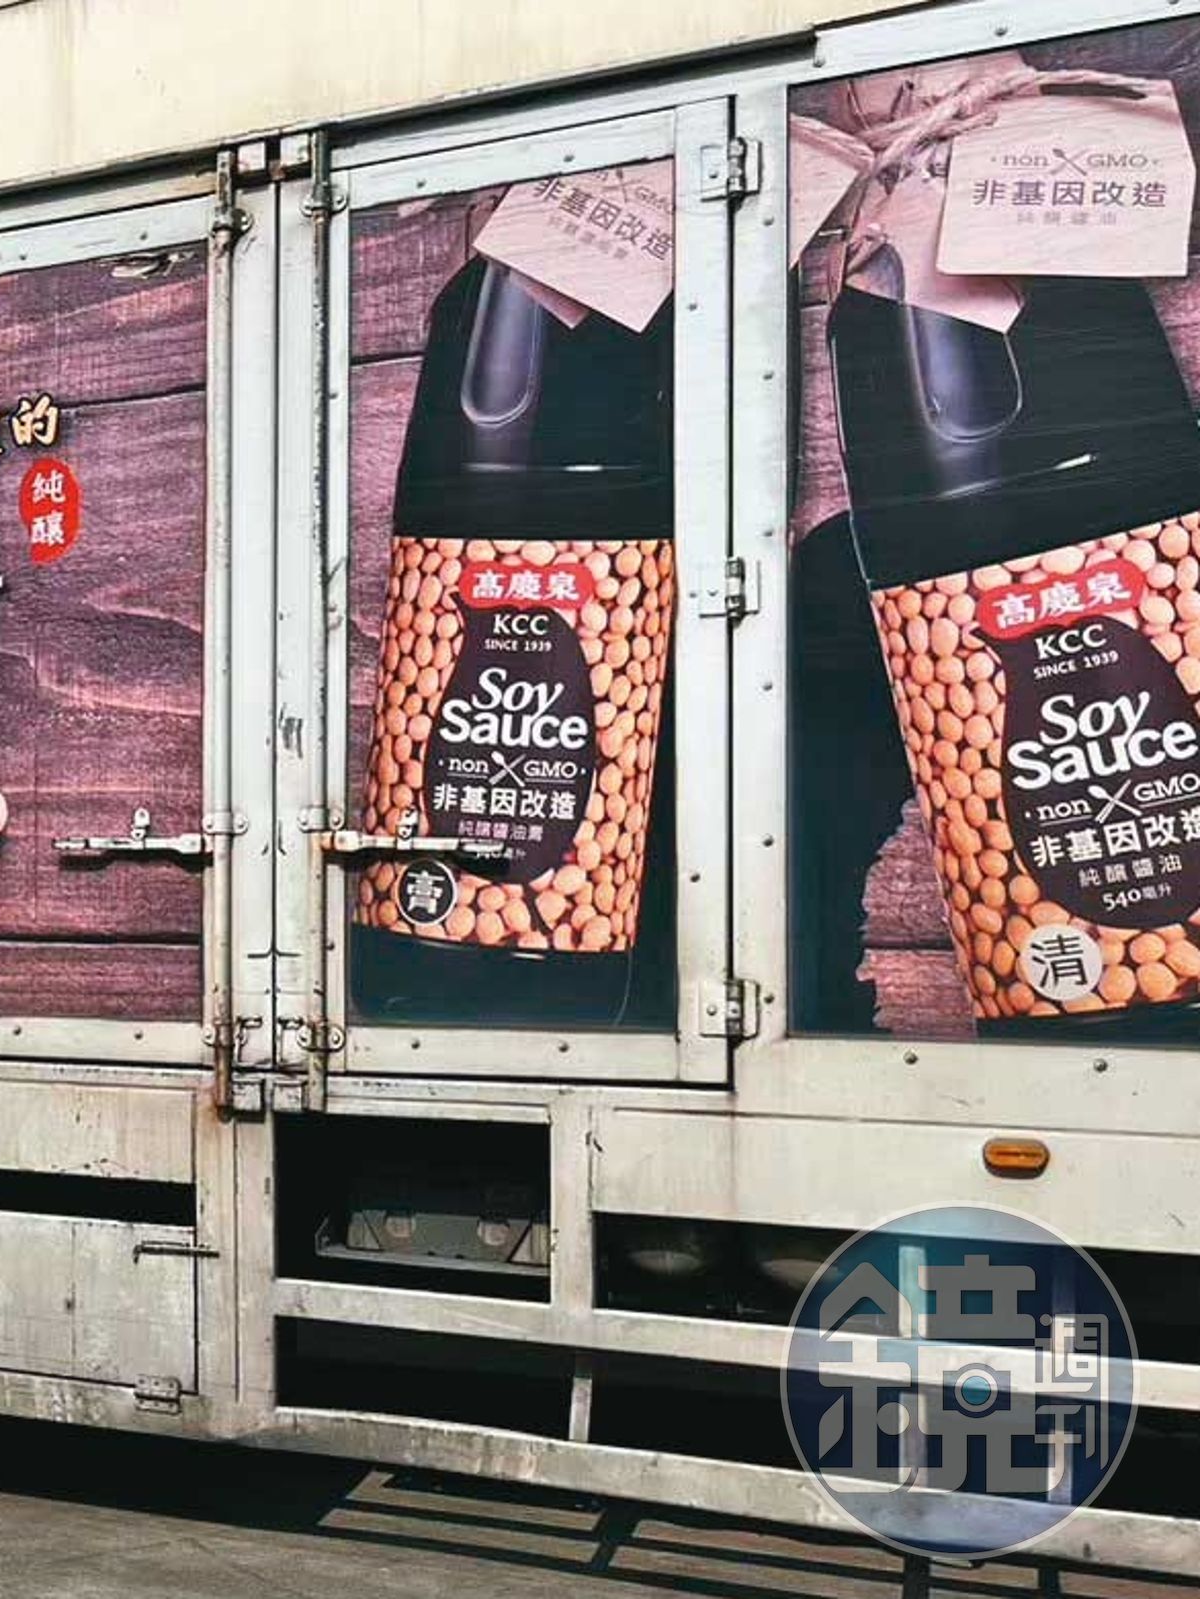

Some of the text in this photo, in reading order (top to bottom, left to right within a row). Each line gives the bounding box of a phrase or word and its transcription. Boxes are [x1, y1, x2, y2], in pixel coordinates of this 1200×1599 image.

[1003, 154, 1148, 168] non GMO
[973, 179, 1166, 207] 非基因改造
[534, 178, 674, 260] 非基因改造
[493, 613, 549, 636] KCC
[1035, 624, 1107, 660] KCC
[484, 638, 552, 652] SINCE 1939
[1033, 650, 1119, 680] SINCE 1939
[472, 667, 564, 723] Soy
[440, 699, 588, 749] Sauce
[1039, 691, 1150, 745] Soy
[448, 757, 578, 778] non GMO
[1007, 721, 1199, 789] Sauce
[433, 783, 577, 819] 非基因改造
[1037, 772, 1200, 820] non GMO
[1030, 933, 1088, 988] 清
